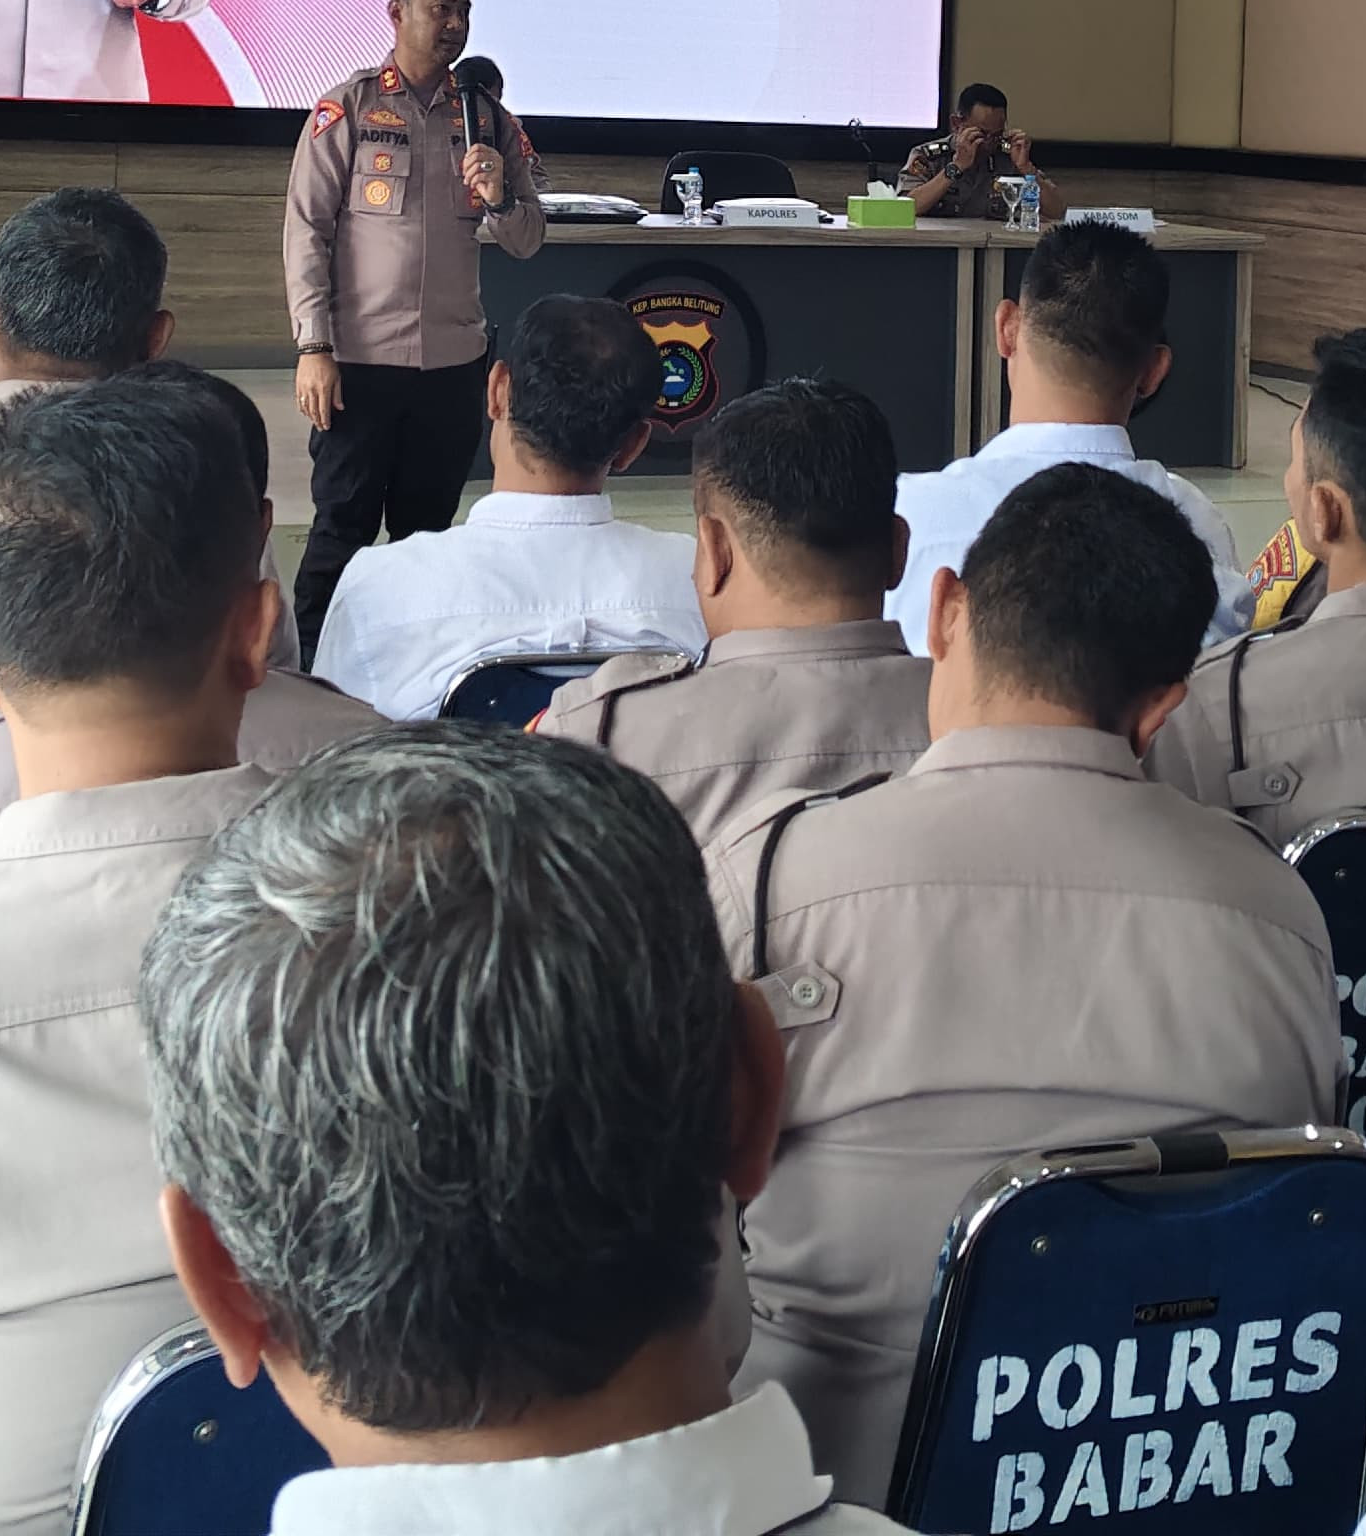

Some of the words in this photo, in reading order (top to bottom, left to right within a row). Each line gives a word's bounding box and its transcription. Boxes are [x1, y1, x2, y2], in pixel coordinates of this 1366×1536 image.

[359, 128, 410, 146] ADITYA
[748, 208, 797, 219] KAPOLRES
[1117, 212, 1138, 221] SDM
[650, 296, 682, 308] BANGKA
[683, 297, 720, 315] BELITUNG
[972, 1310, 1343, 1442] POLRES
[989, 1408, 1299, 1536] BABAR
